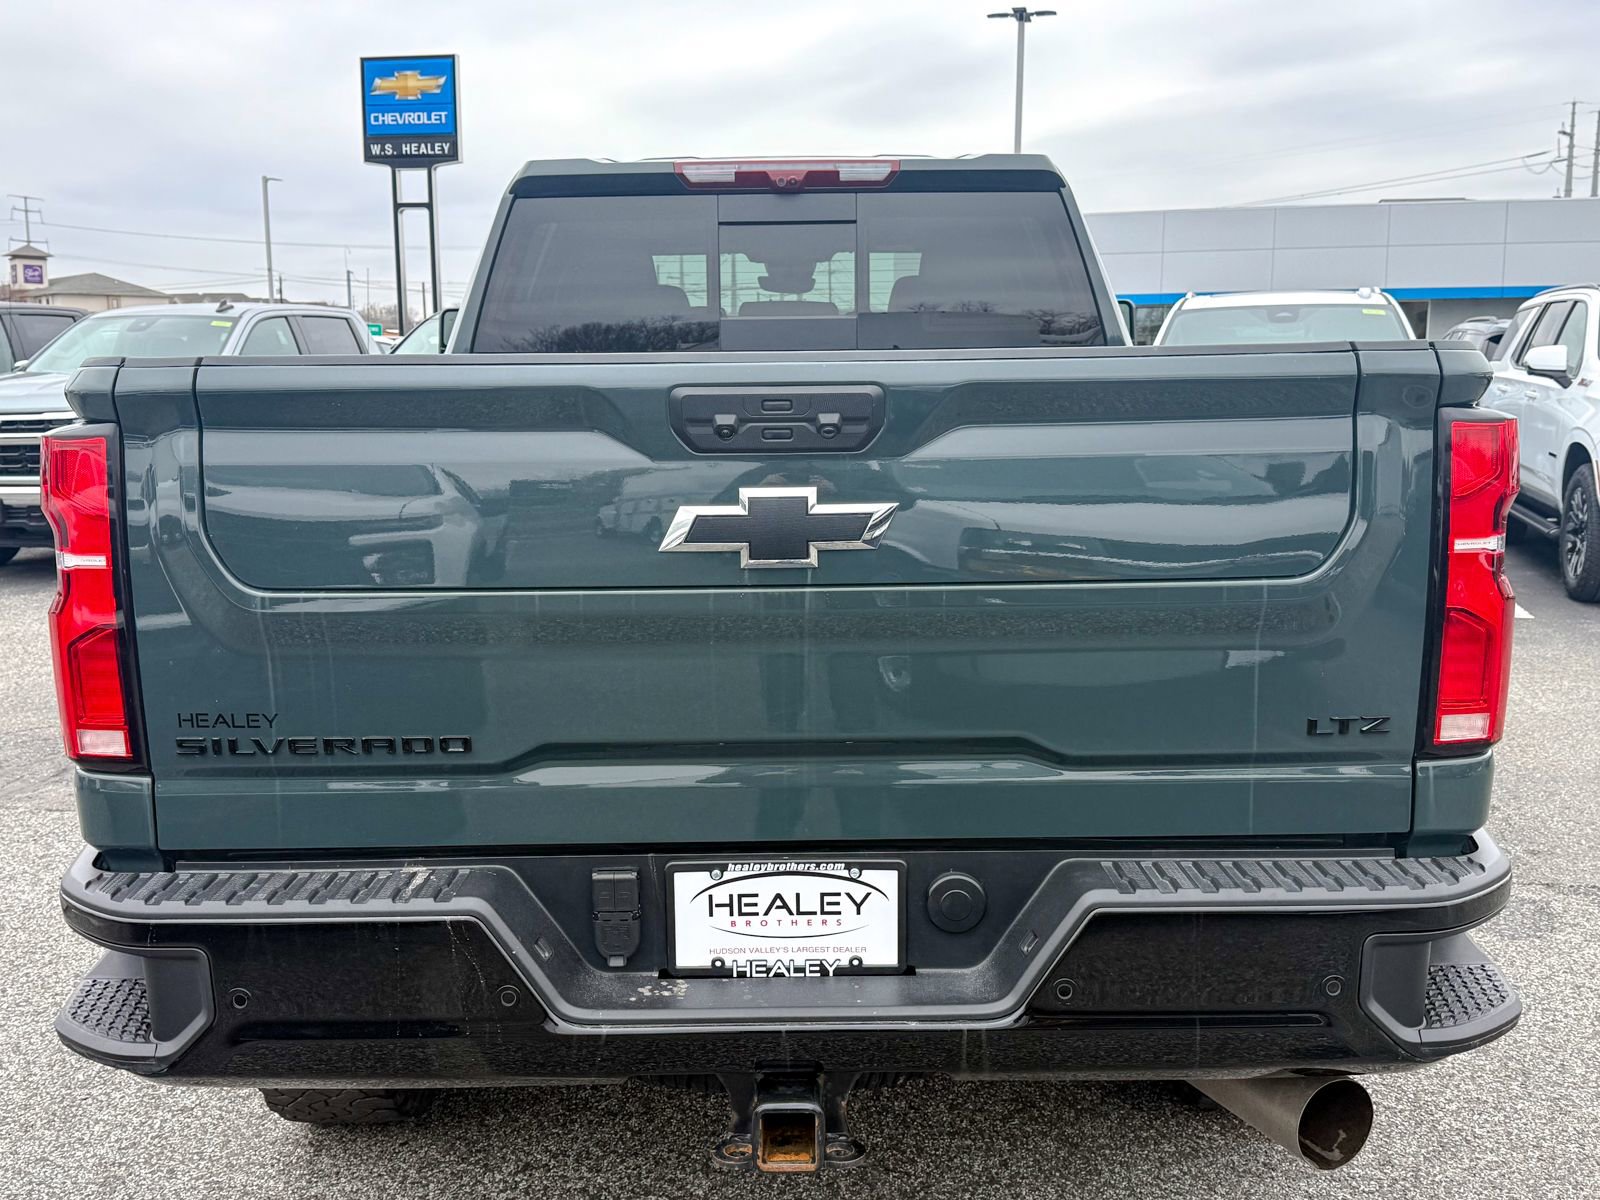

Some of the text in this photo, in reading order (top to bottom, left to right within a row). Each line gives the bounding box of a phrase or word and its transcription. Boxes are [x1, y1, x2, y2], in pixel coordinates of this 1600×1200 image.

[370, 112, 448, 125] CHEVROLET
[370, 143, 450, 155] W.S. HEALEY
[177, 713, 278, 729] HEALEY
[1307, 716, 1391, 736] LTZ
[176, 737, 472, 755] SILVERADO
[727, 863, 845, 872] healeybrothers.com
[708, 892, 872, 917] HEALEY
[730, 918, 842, 928] BROTHERS
[732, 959, 841, 978] HEALEY
